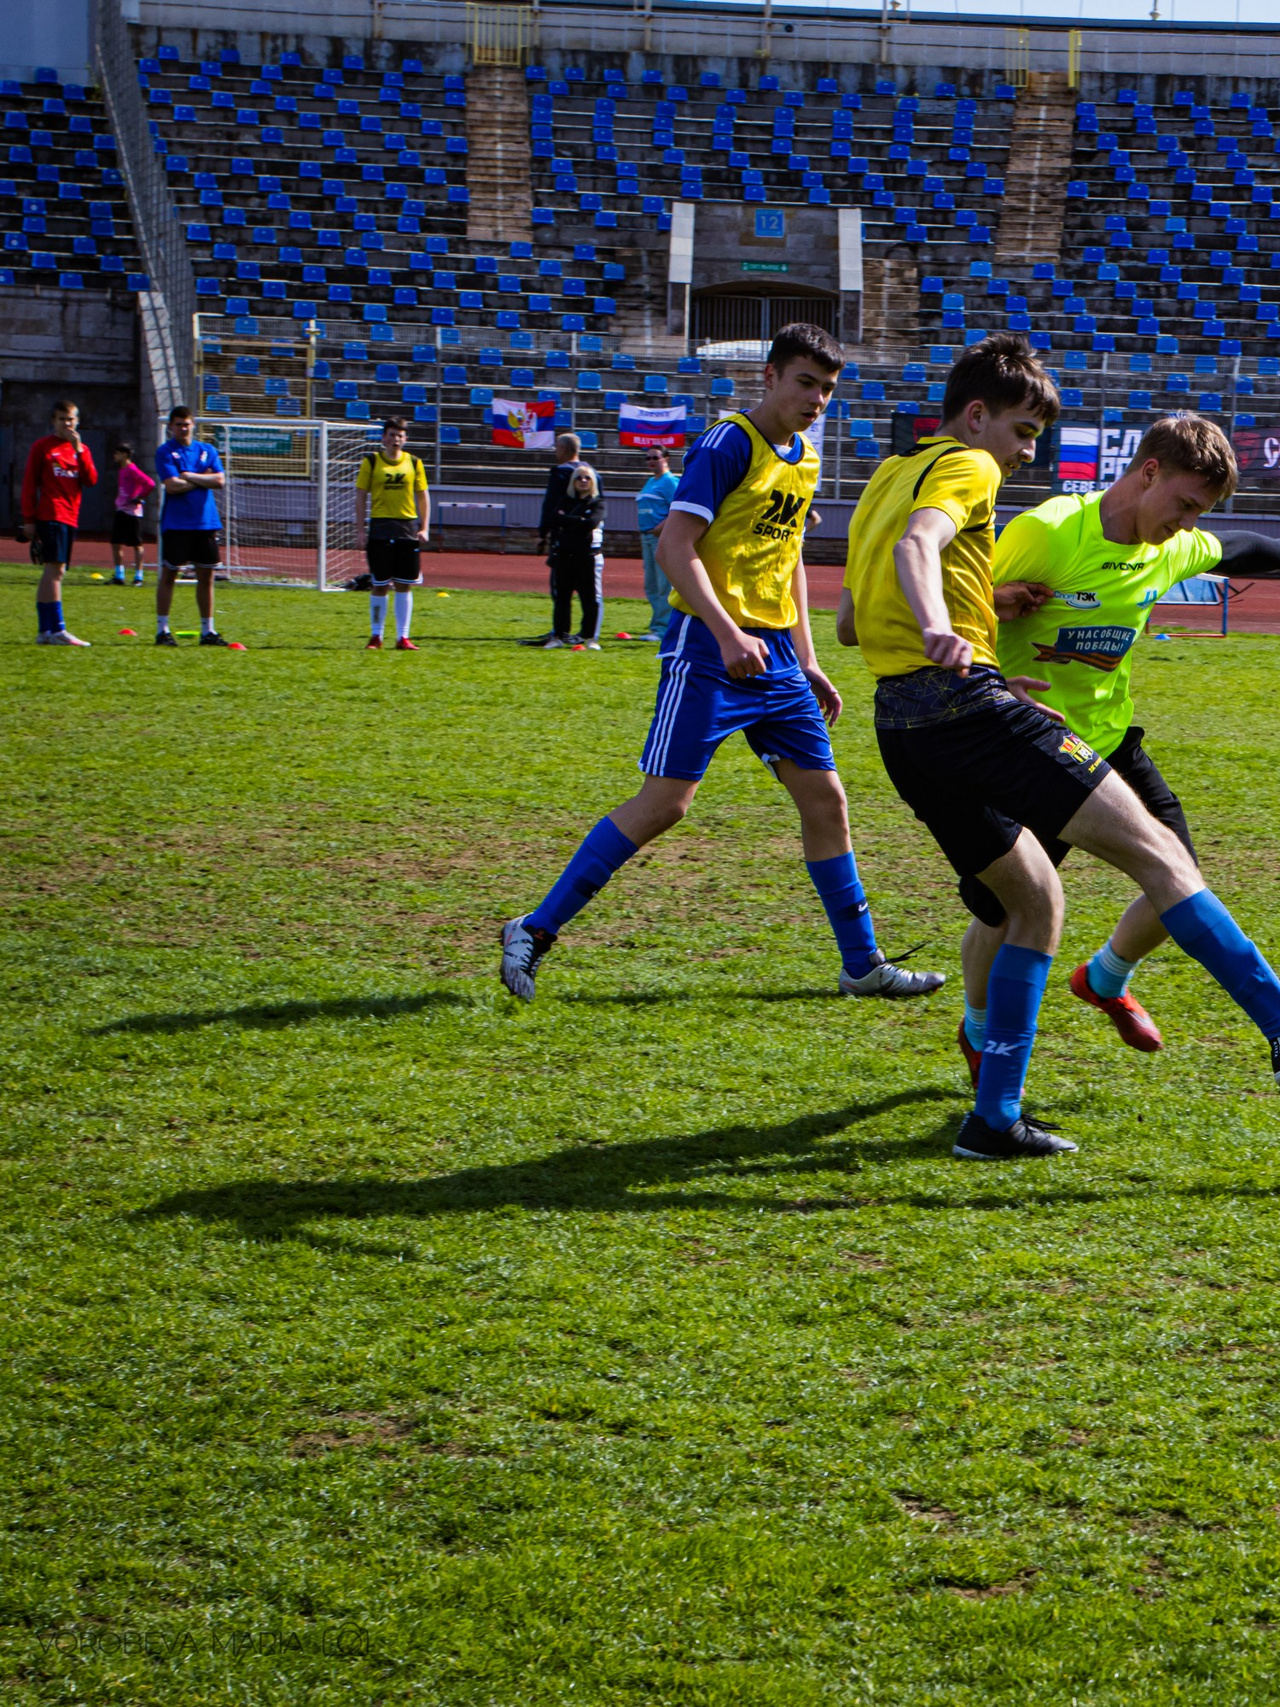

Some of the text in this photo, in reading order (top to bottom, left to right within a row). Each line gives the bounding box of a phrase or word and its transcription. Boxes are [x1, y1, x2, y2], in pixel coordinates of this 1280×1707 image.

[760, 215, 779, 230] 12
[761, 488, 806, 528] 2K
[1101, 562, 1145, 571] GIVOVA
[1077, 629, 1100, 639] НАС
[1100, 629, 1132, 641] ОБЩИЕ
[1075, 641, 1124, 652] ПОБЕДЫ!
[983, 1040, 1018, 1056] 2K
